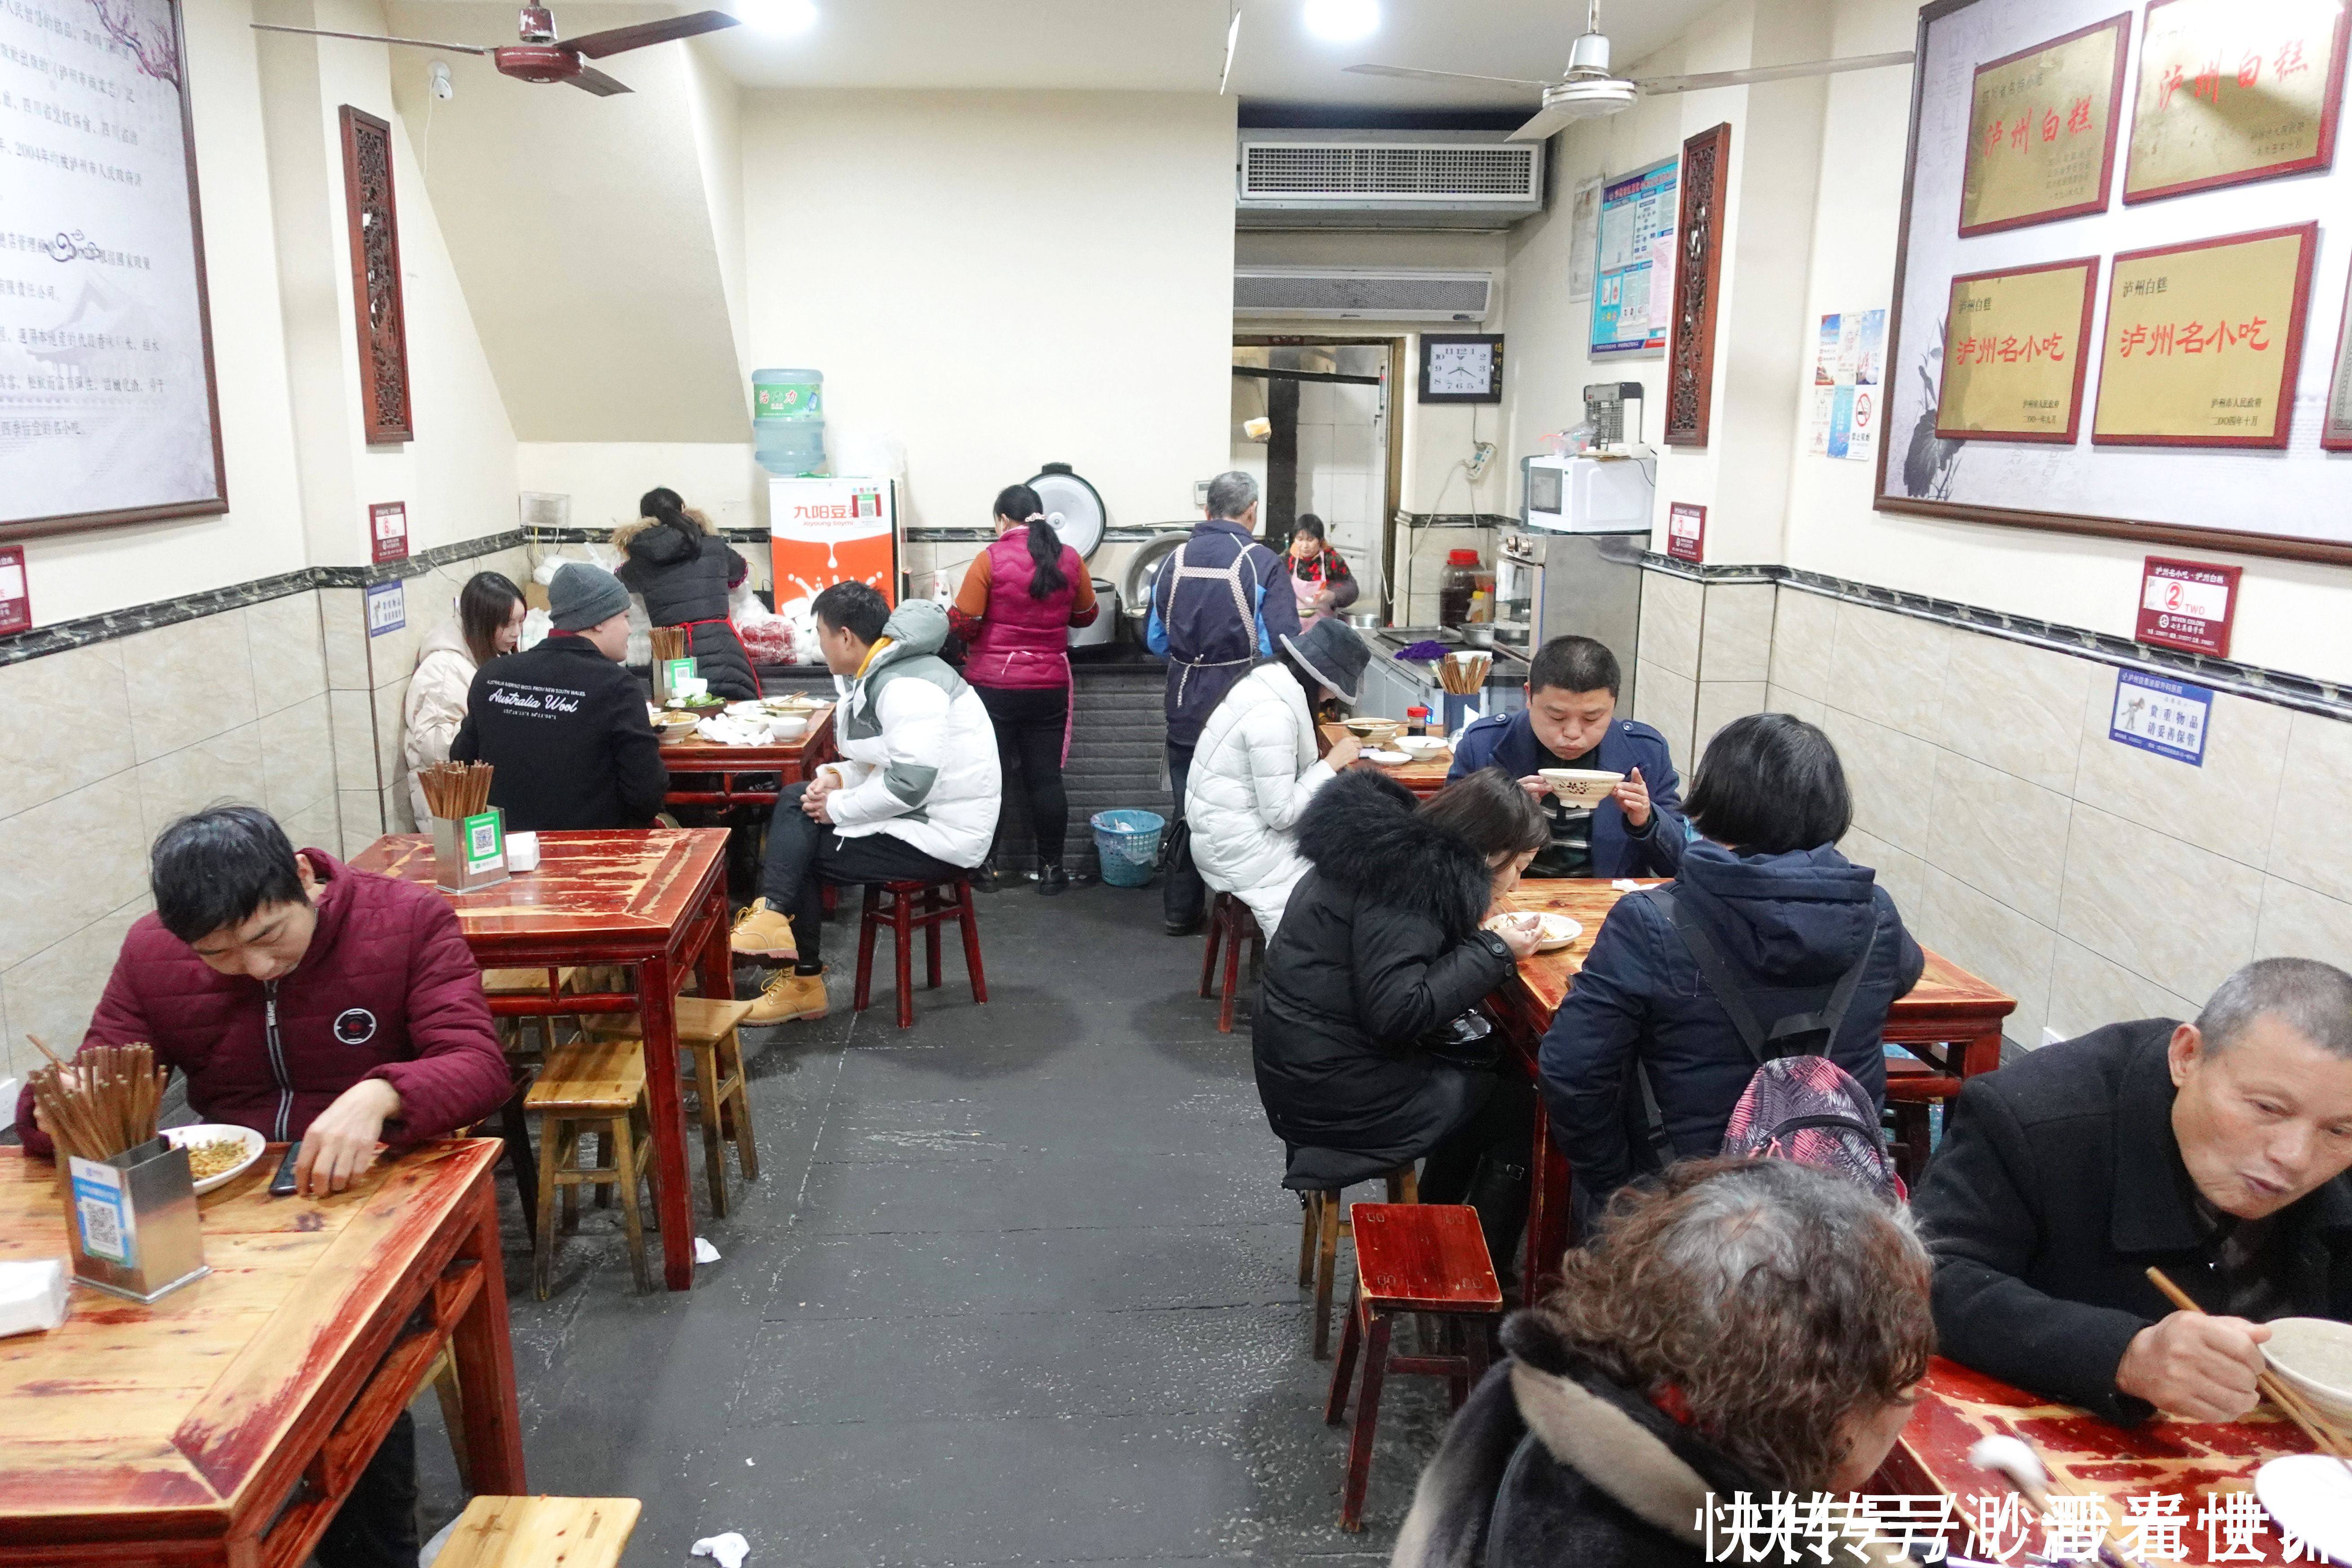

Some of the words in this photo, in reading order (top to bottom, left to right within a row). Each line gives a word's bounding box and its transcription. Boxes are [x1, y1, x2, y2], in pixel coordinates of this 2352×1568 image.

[2159, 39, 2308, 112] 泸州白糕
[1983, 95, 2093, 159] 泸州白糕
[2123, 276, 2168, 298] 泸州白糕
[1959, 297, 1991, 314] 泸州白糕
[1956, 332, 2065, 365] 泸州名小吃
[2120, 316, 2270, 358] 泸州名小吃
[759, 389, 770, 404] 活
[784, 389, 797, 404] 力
[2211, 397, 2263, 409] 泸州市人民政府
[2185, 603, 2205, 616] TWO
[489, 688, 540, 708] Australia
[545, 695, 579, 713] Wool
[2150, 704, 2198, 729] 贵重物品
[2147, 722, 2195, 748] 请妥善保管
